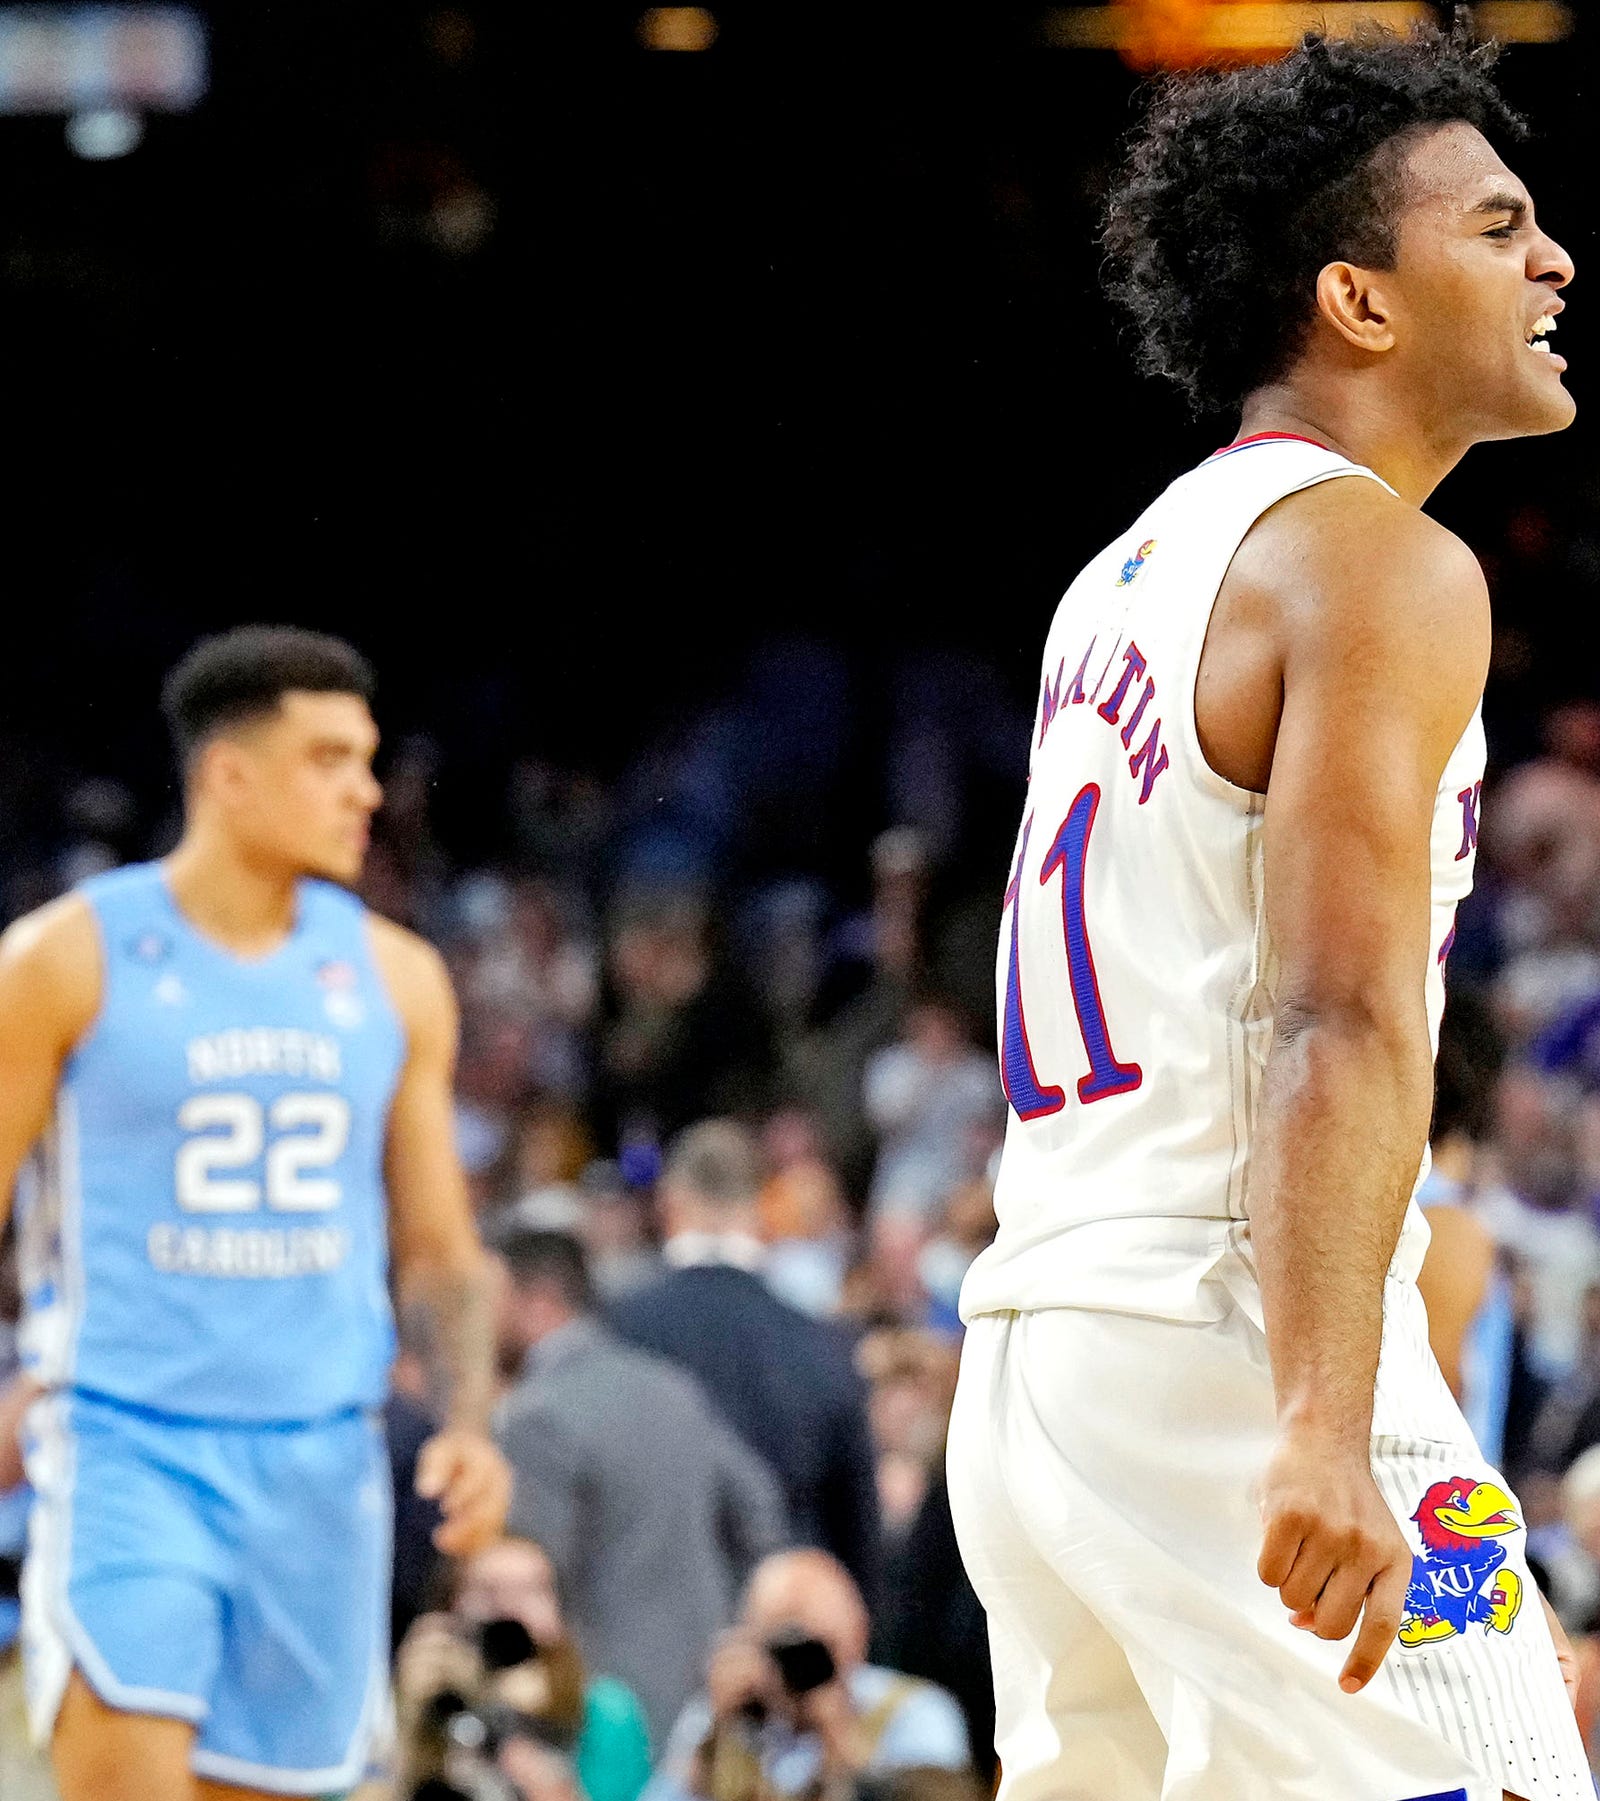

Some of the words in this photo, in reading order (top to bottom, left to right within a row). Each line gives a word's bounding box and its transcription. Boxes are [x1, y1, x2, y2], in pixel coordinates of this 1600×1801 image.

[1039, 633, 1169, 805] MATIN
[1003, 782, 1142, 1122] 11
[186, 1028, 342, 1083] NORTH
[176, 1093, 351, 1213] 22
[1426, 1563, 1474, 1598] KU
